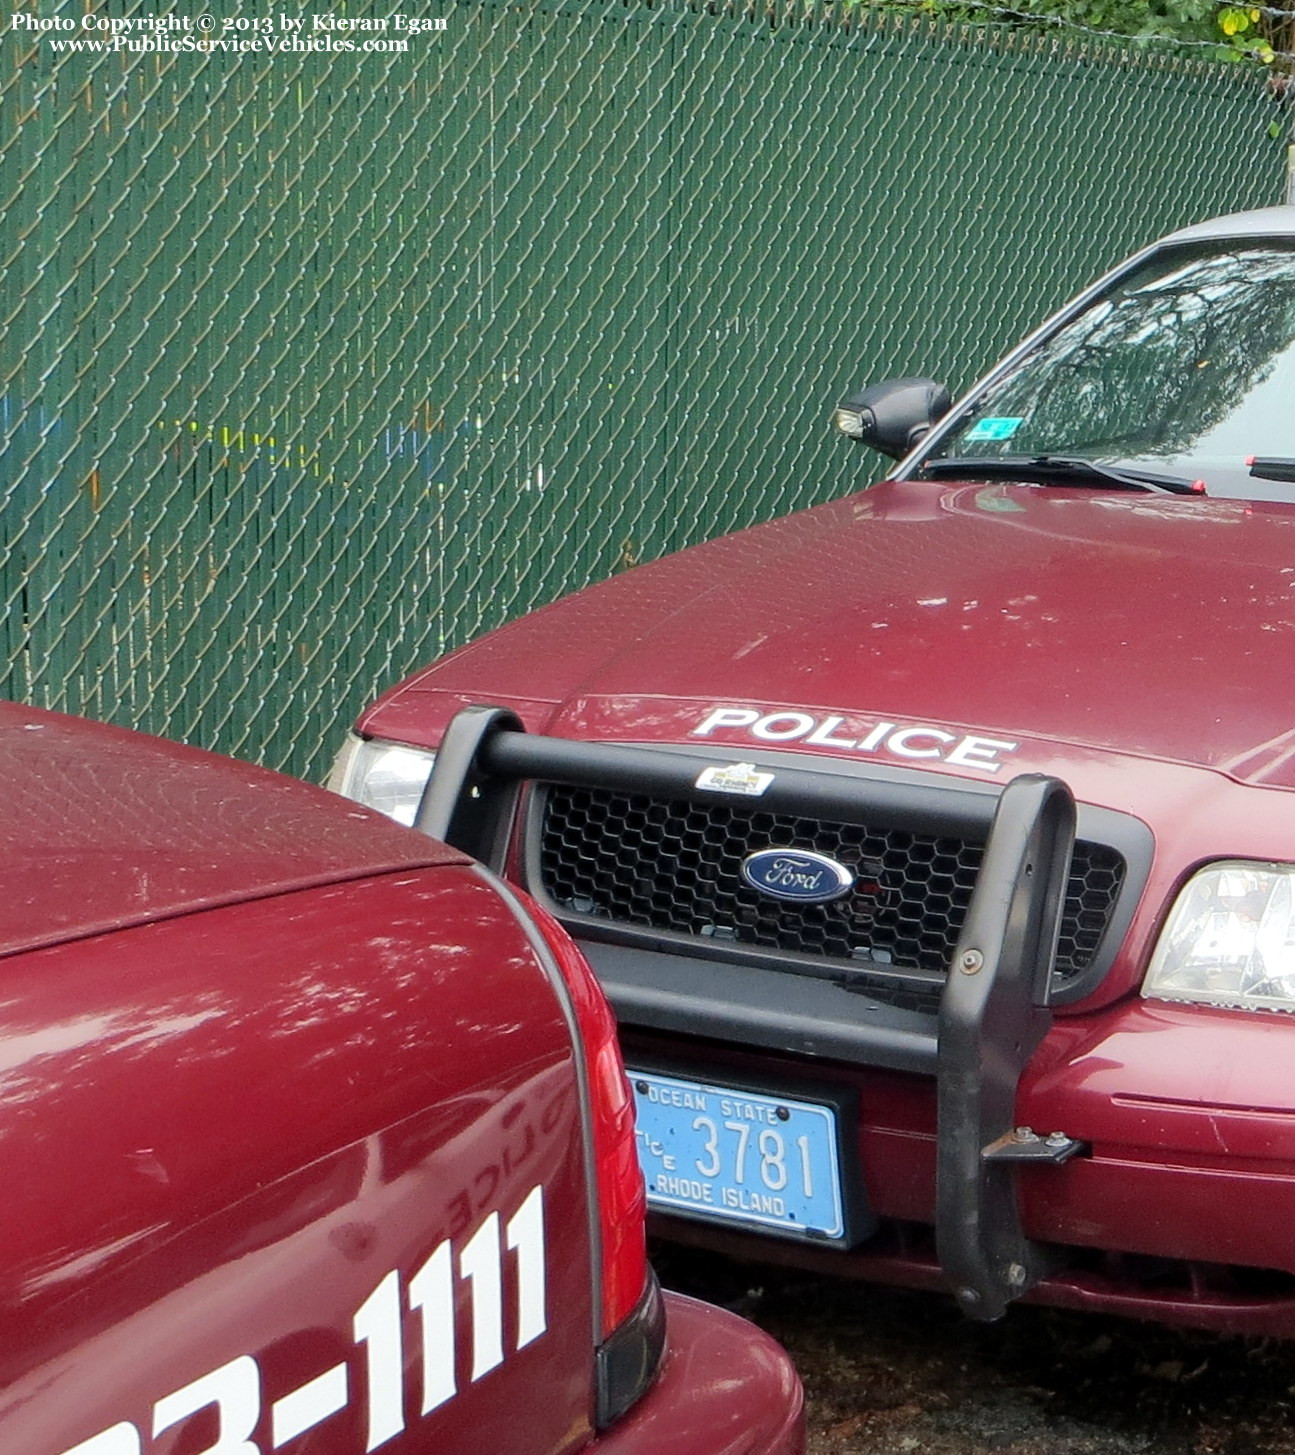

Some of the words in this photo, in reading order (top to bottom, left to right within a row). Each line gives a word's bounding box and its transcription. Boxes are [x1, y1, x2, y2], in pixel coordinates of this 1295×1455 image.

[691, 707, 1018, 773] POLICE
[765, 857, 824, 890] Ford
[648, 1085, 707, 1112] OCEAN
[721, 1099, 779, 1125] STATE
[692, 1116, 813, 1198] 3781
[656, 1173, 714, 1203] RHODE
[722, 1186, 785, 1217] ISLAND
[57, 1184, 548, 1455] 3-1111
